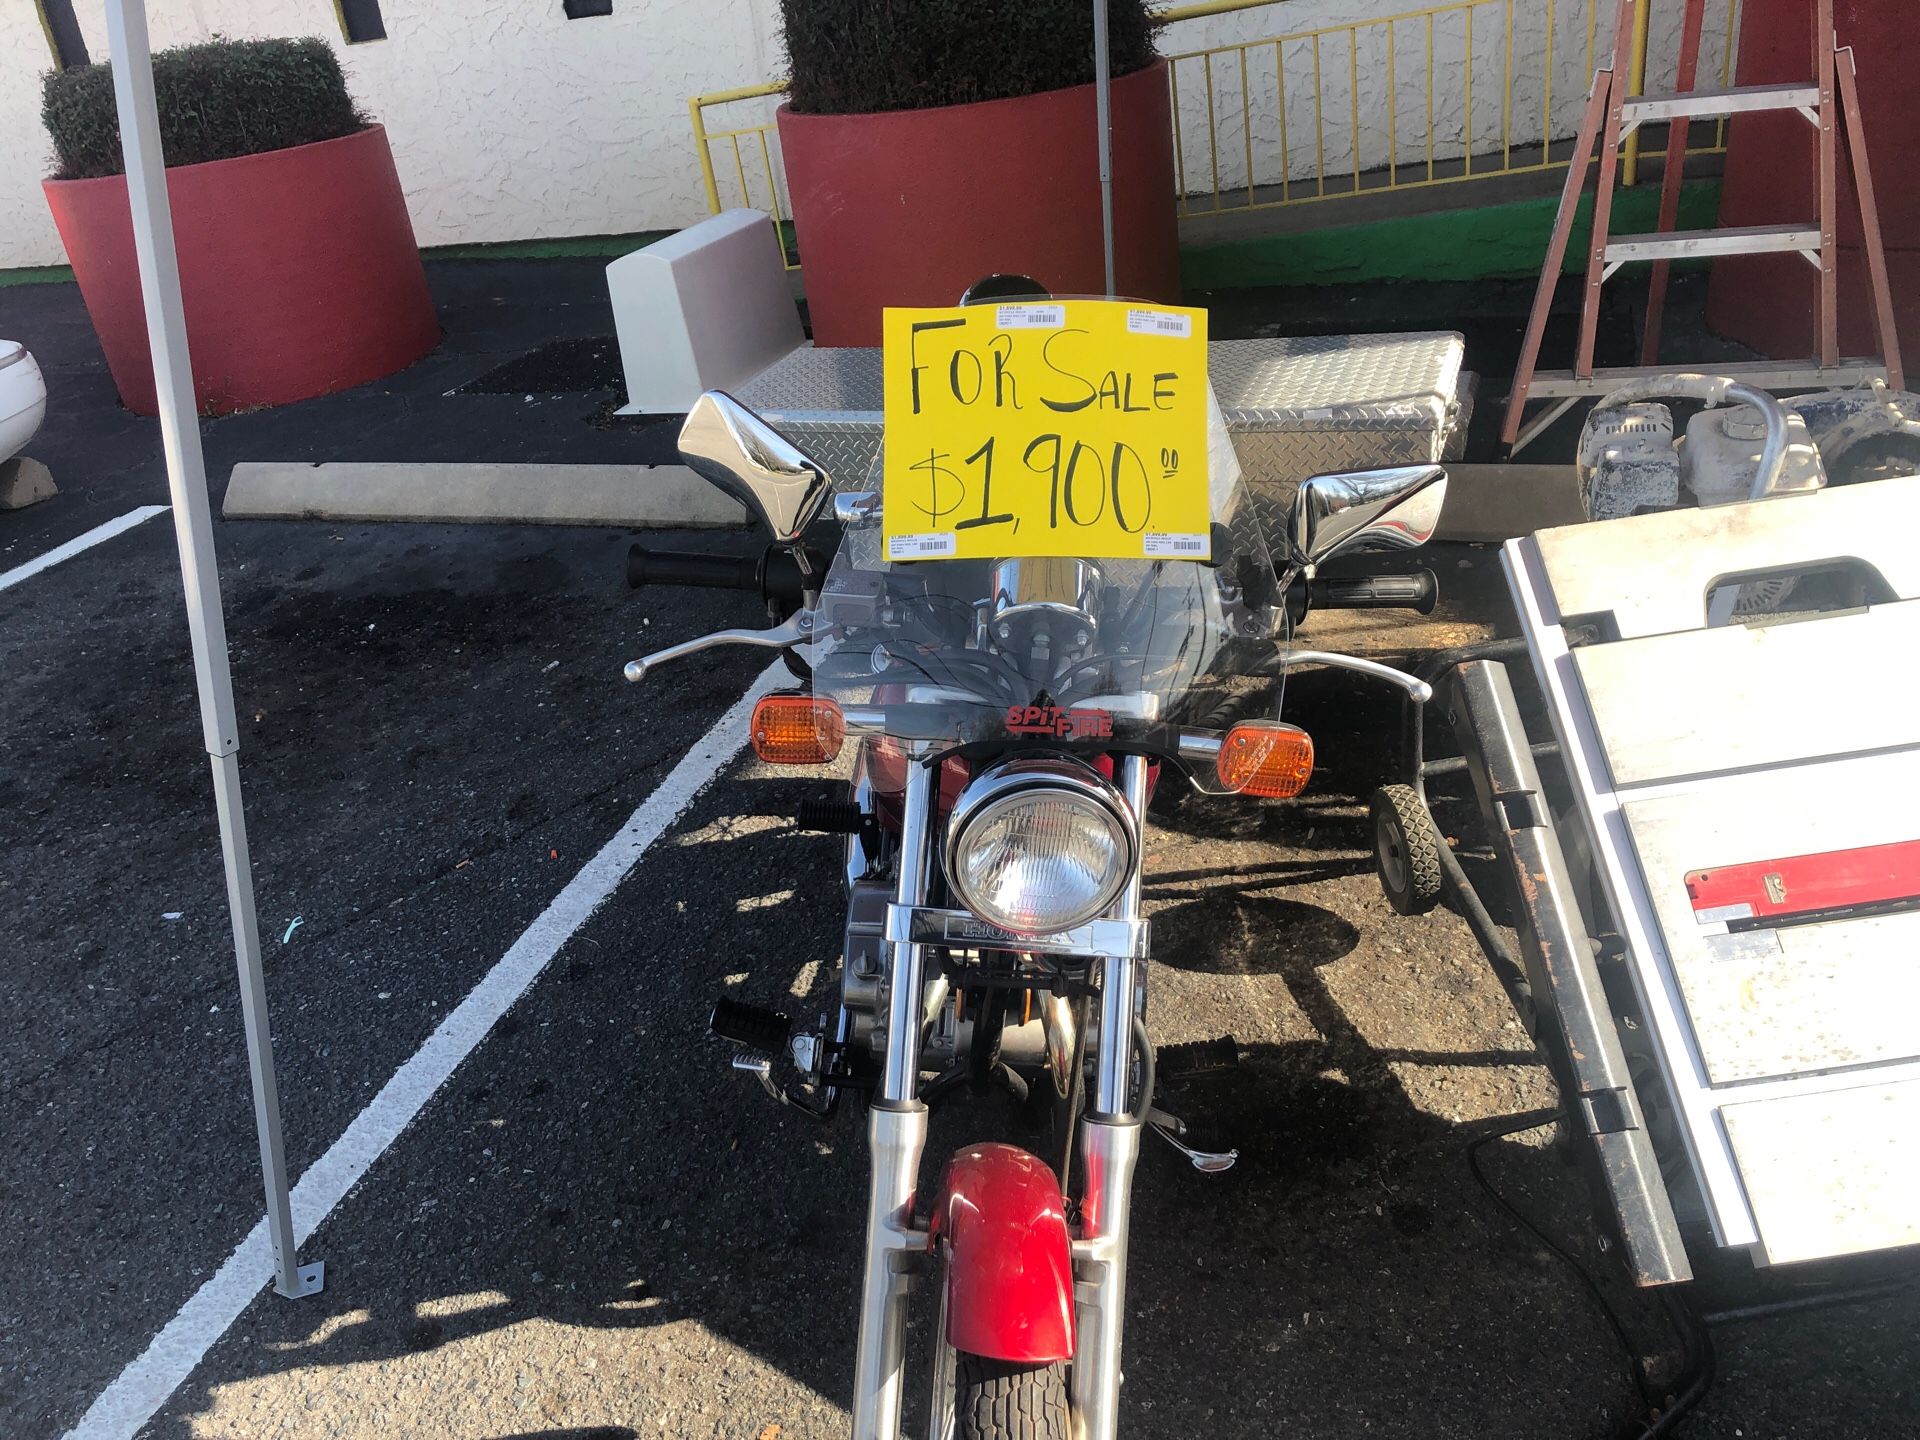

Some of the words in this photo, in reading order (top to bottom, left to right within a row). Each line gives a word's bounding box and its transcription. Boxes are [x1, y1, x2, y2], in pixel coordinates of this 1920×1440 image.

[911, 318, 1024, 415] FOR
[1039, 328, 1179, 413] SALE
[1056, 718, 1113, 737] FIRE
[962, 920, 1075, 944] HOA
